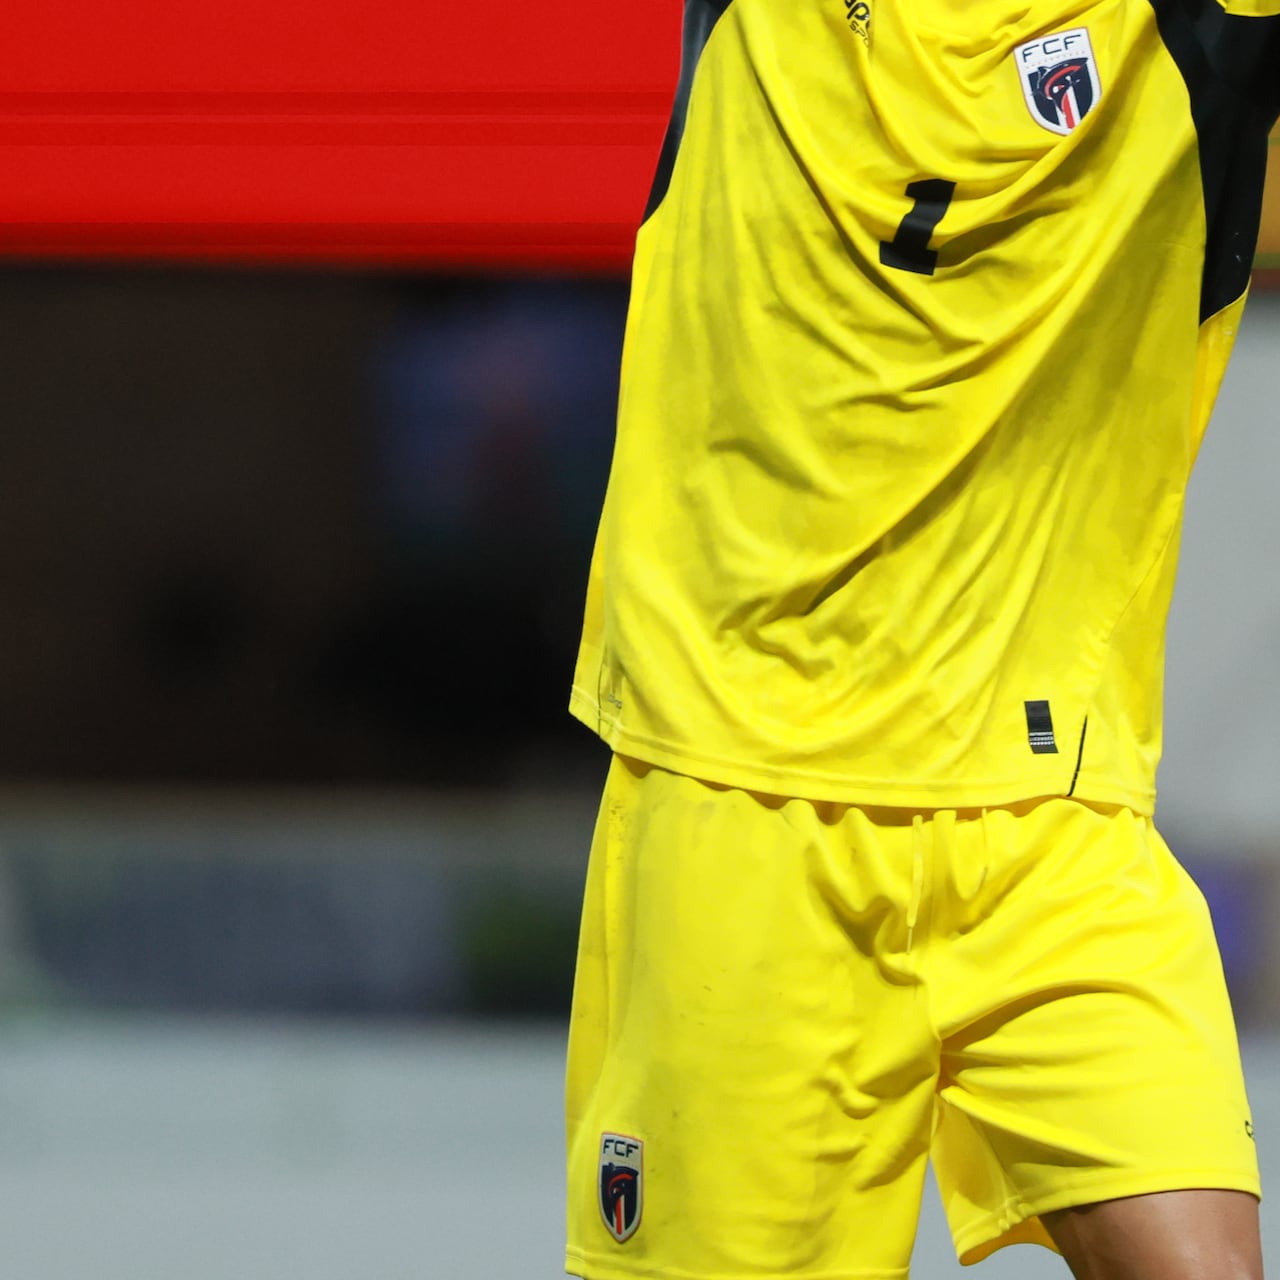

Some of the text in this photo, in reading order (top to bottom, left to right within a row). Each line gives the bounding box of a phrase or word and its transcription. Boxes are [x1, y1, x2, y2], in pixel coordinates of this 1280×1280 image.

[1022, 34, 1082, 63] FCF
[879, 178, 957, 276] 1
[603, 1139, 639, 1158] FCF
